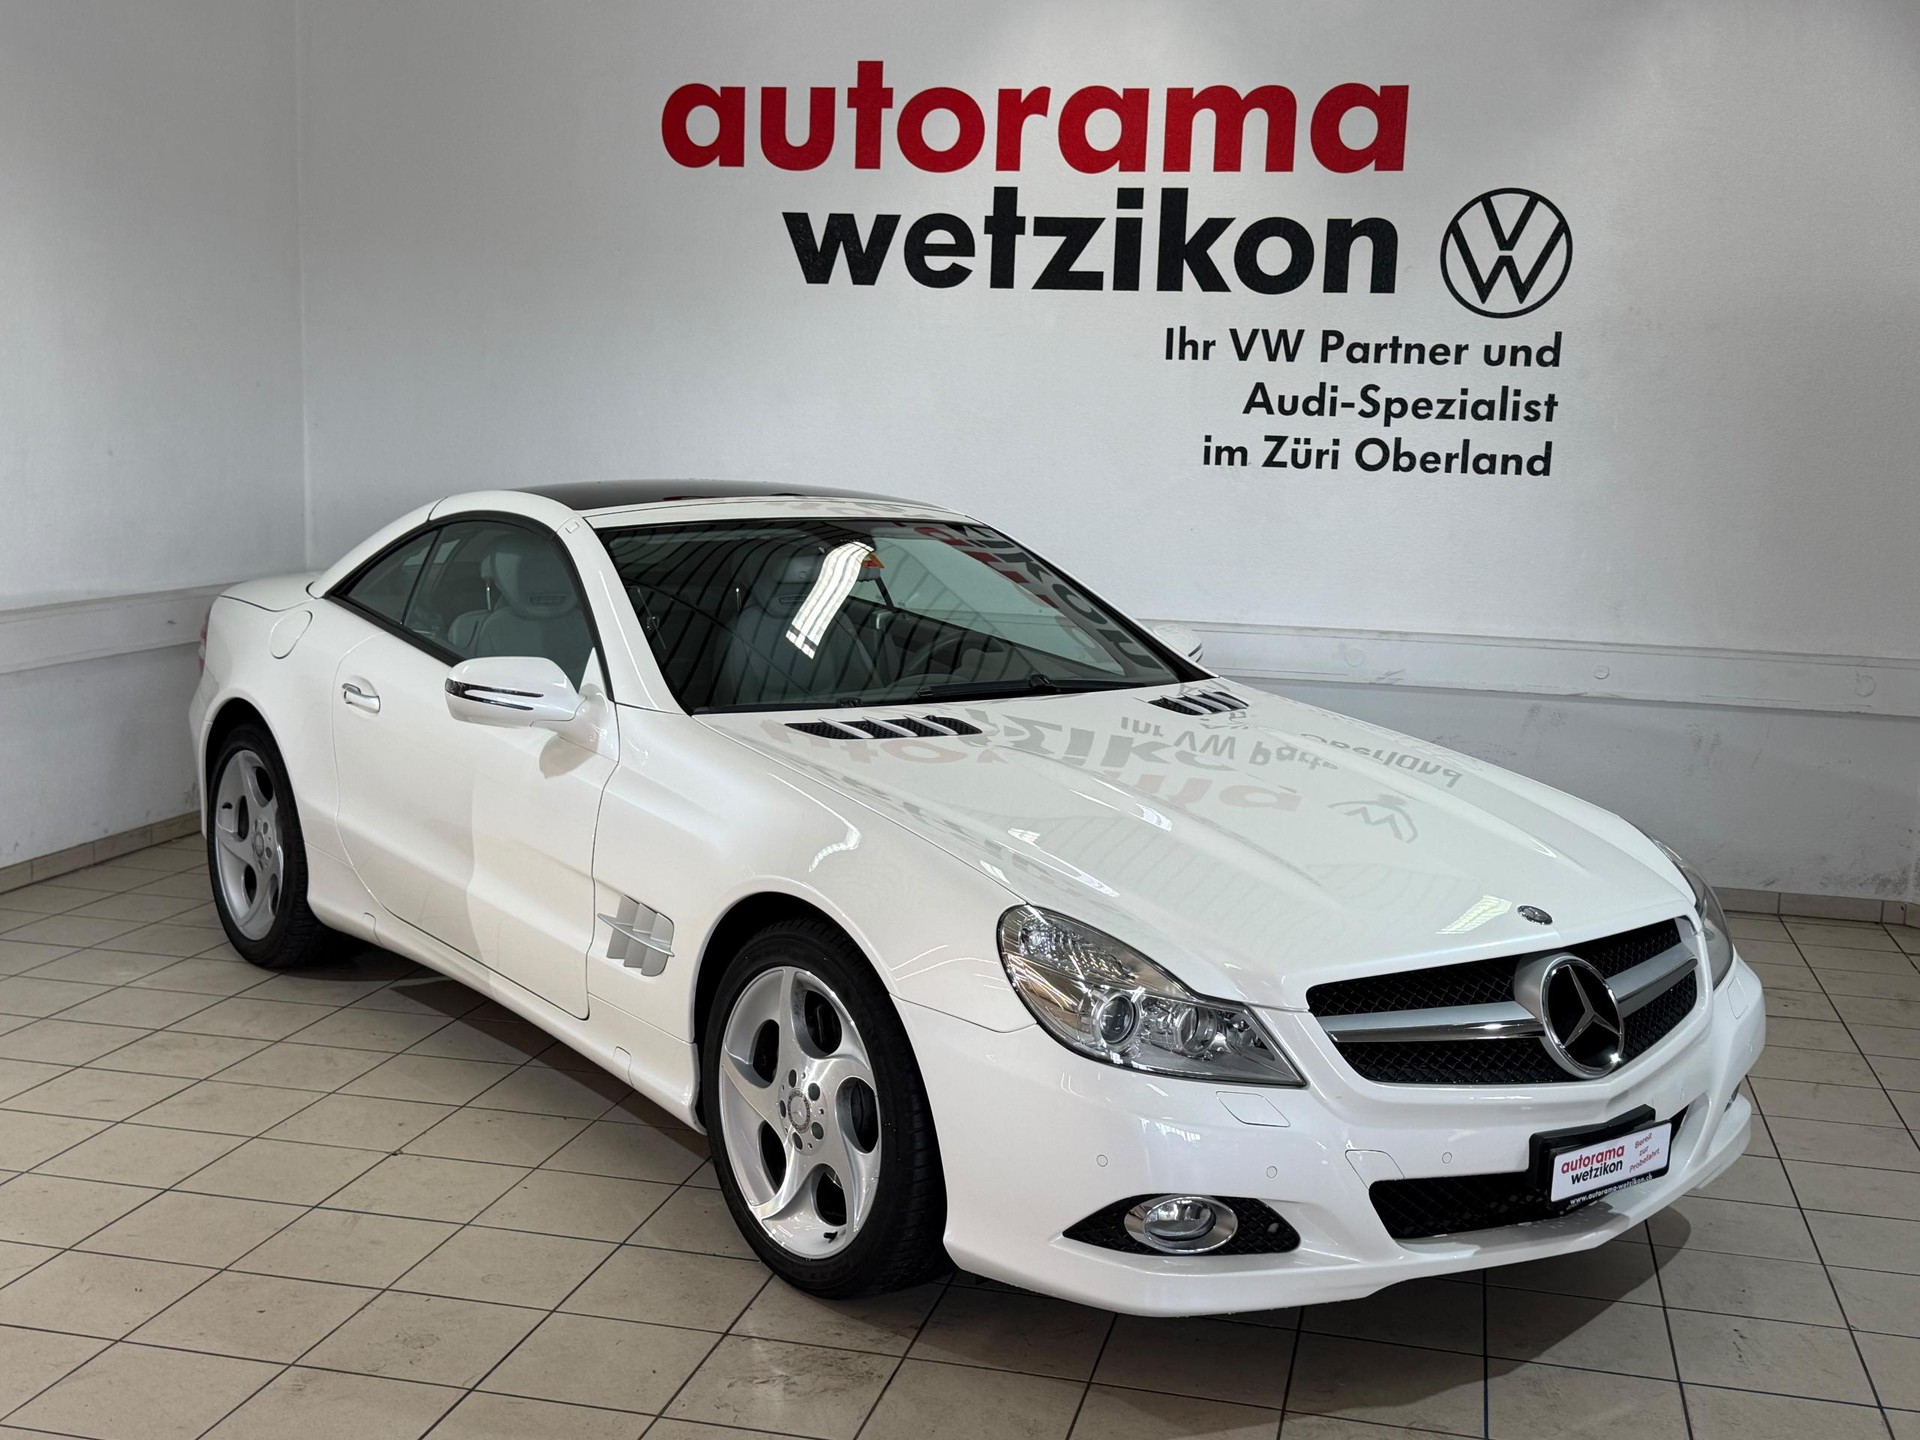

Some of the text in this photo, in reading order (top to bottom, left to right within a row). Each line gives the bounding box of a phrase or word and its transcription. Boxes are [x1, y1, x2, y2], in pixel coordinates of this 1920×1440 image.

[662, 61, 1409, 174] autorama
[782, 187, 1398, 294] wetzikon
[1440, 188, 1572, 318] VW
[1166, 326, 1562, 367] Ihr VW Partner und
[1243, 382, 1559, 427] Audi-Spezialist
[1204, 435, 1552, 476] im Züri Oberland
[1561, 1145, 1625, 1174] autorama
[1571, 1160, 1623, 1185] wetzikon
[1570, 1173, 1653, 1205] www.autorama-wetzikon.ch
